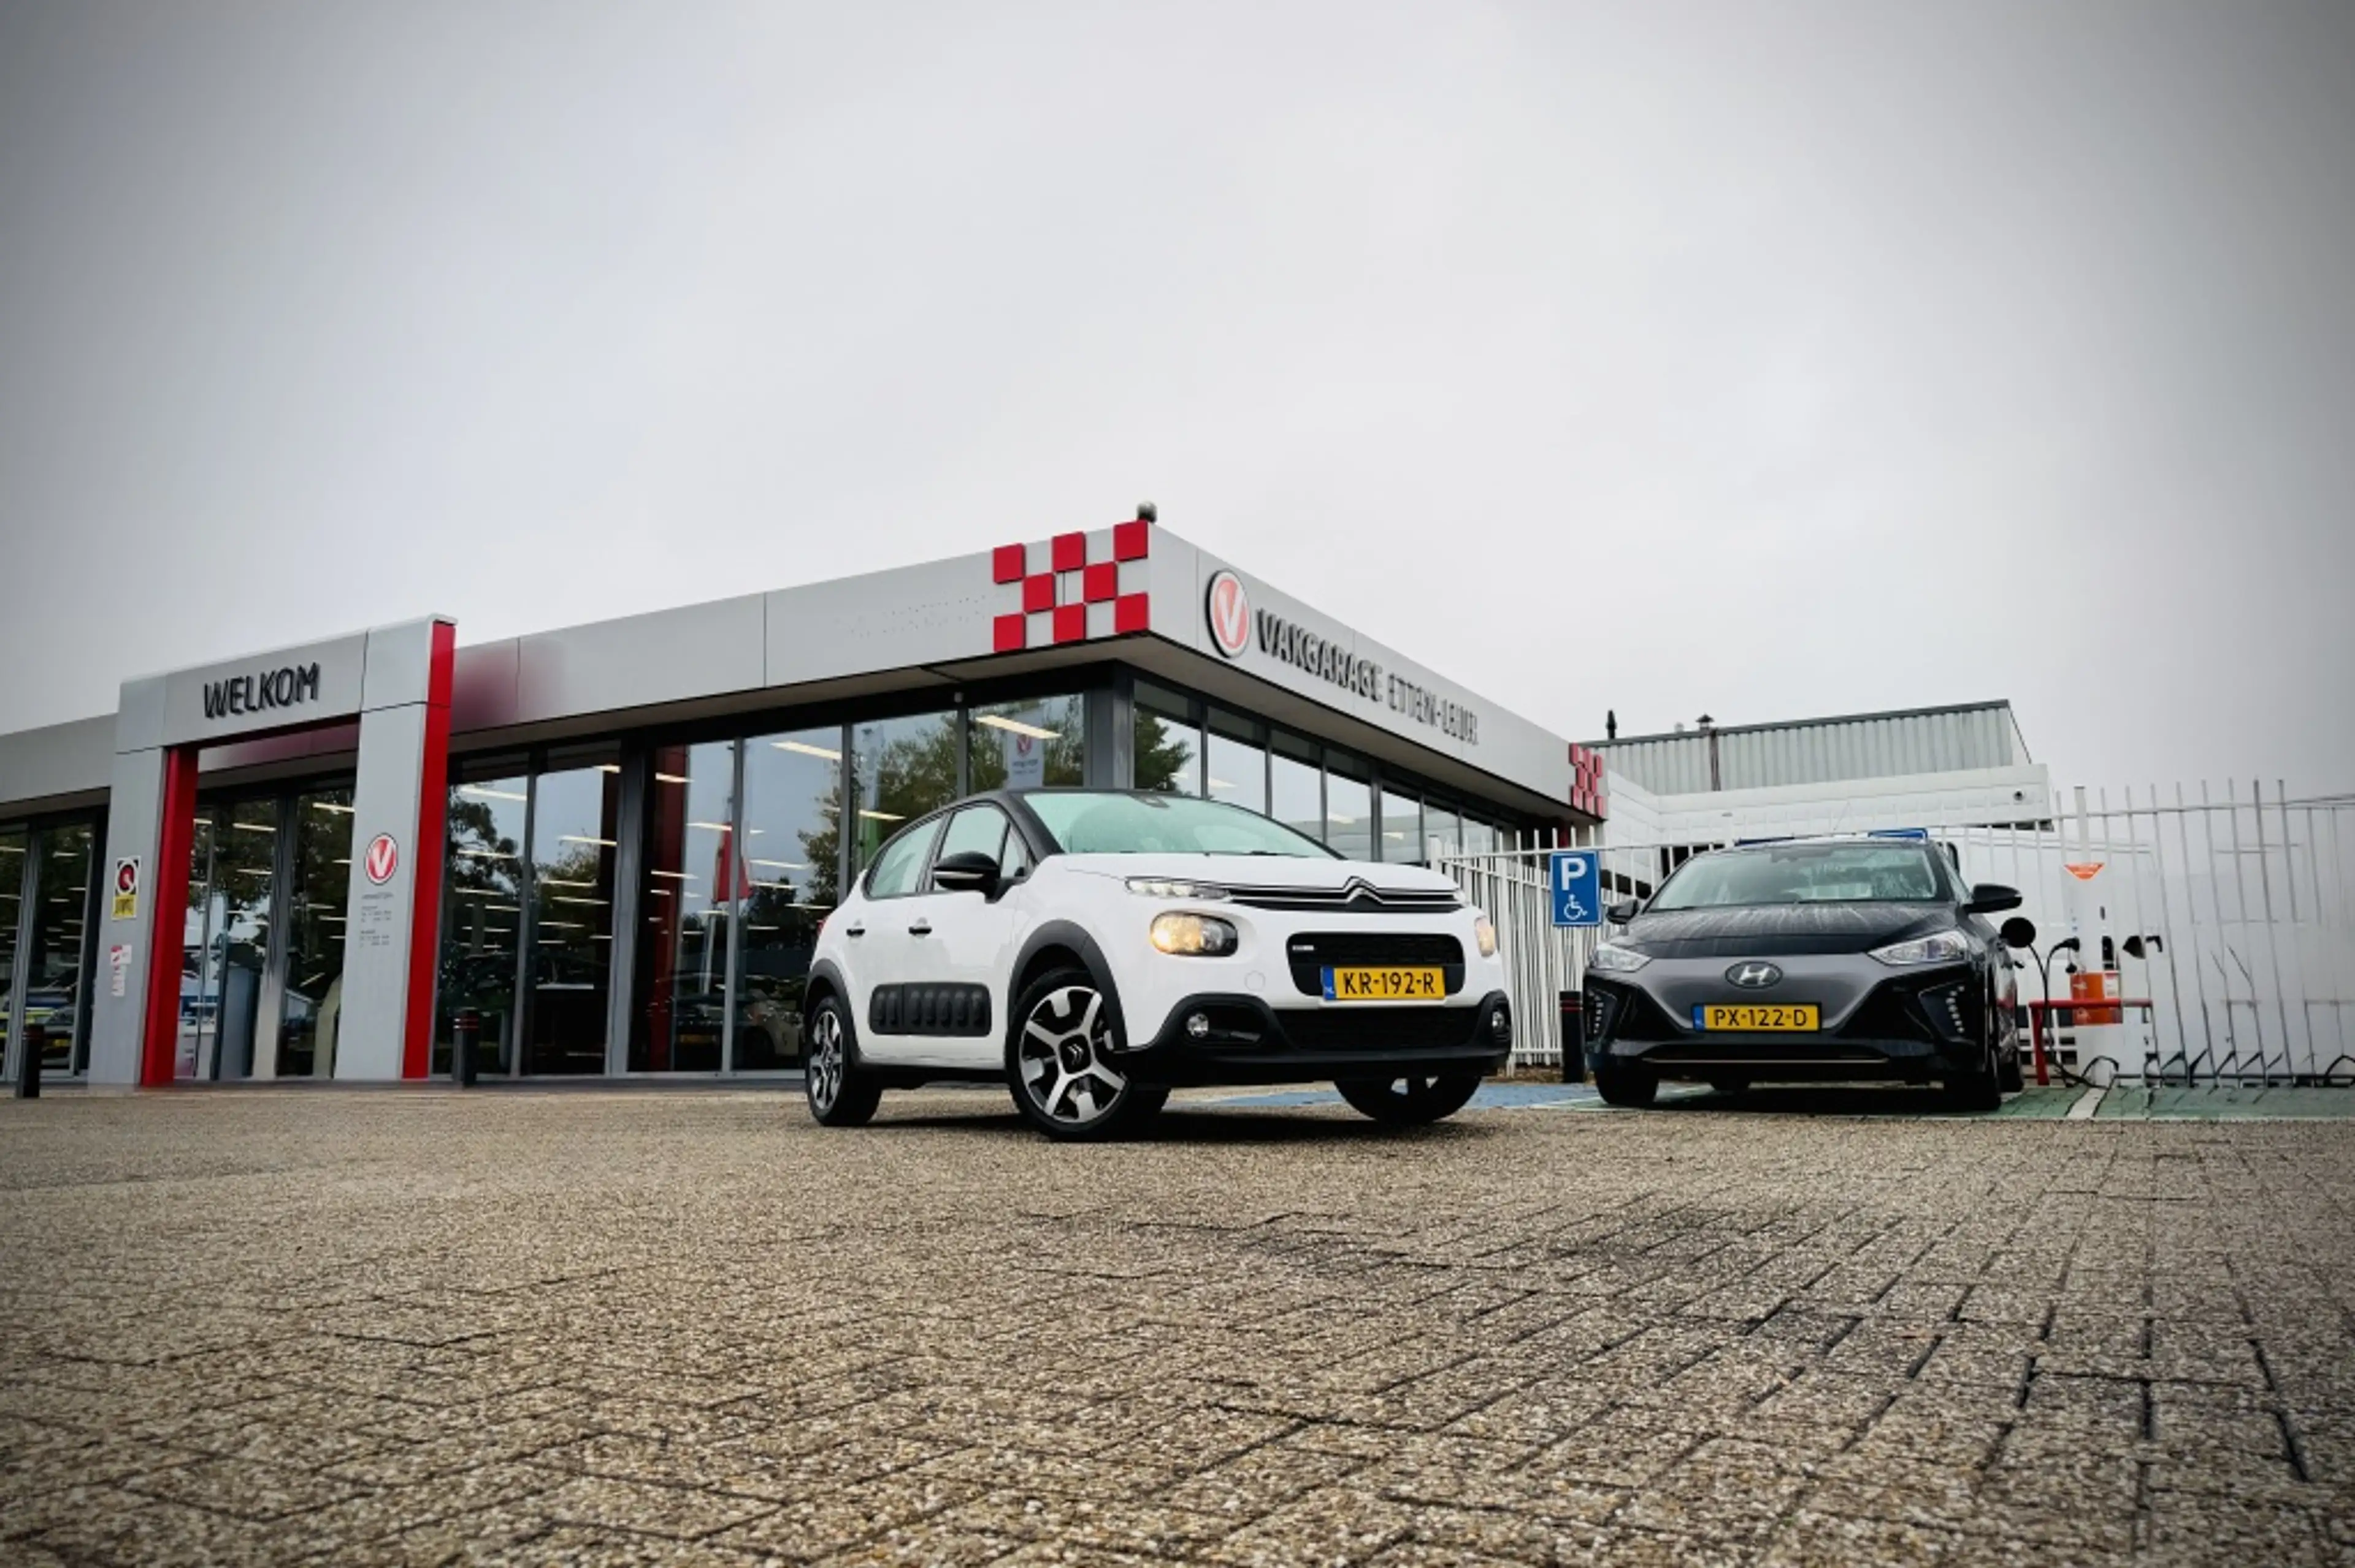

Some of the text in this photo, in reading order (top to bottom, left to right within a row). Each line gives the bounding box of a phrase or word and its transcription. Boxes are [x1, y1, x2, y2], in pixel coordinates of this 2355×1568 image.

[1257, 607, 1382, 703] VAKGARAGE
[204, 662, 320, 719] WELKOM
[1561, 857, 1587, 891] P
[1343, 972, 1435, 995] KR-192-R
[1714, 1009, 1807, 1027] PX-122-D
